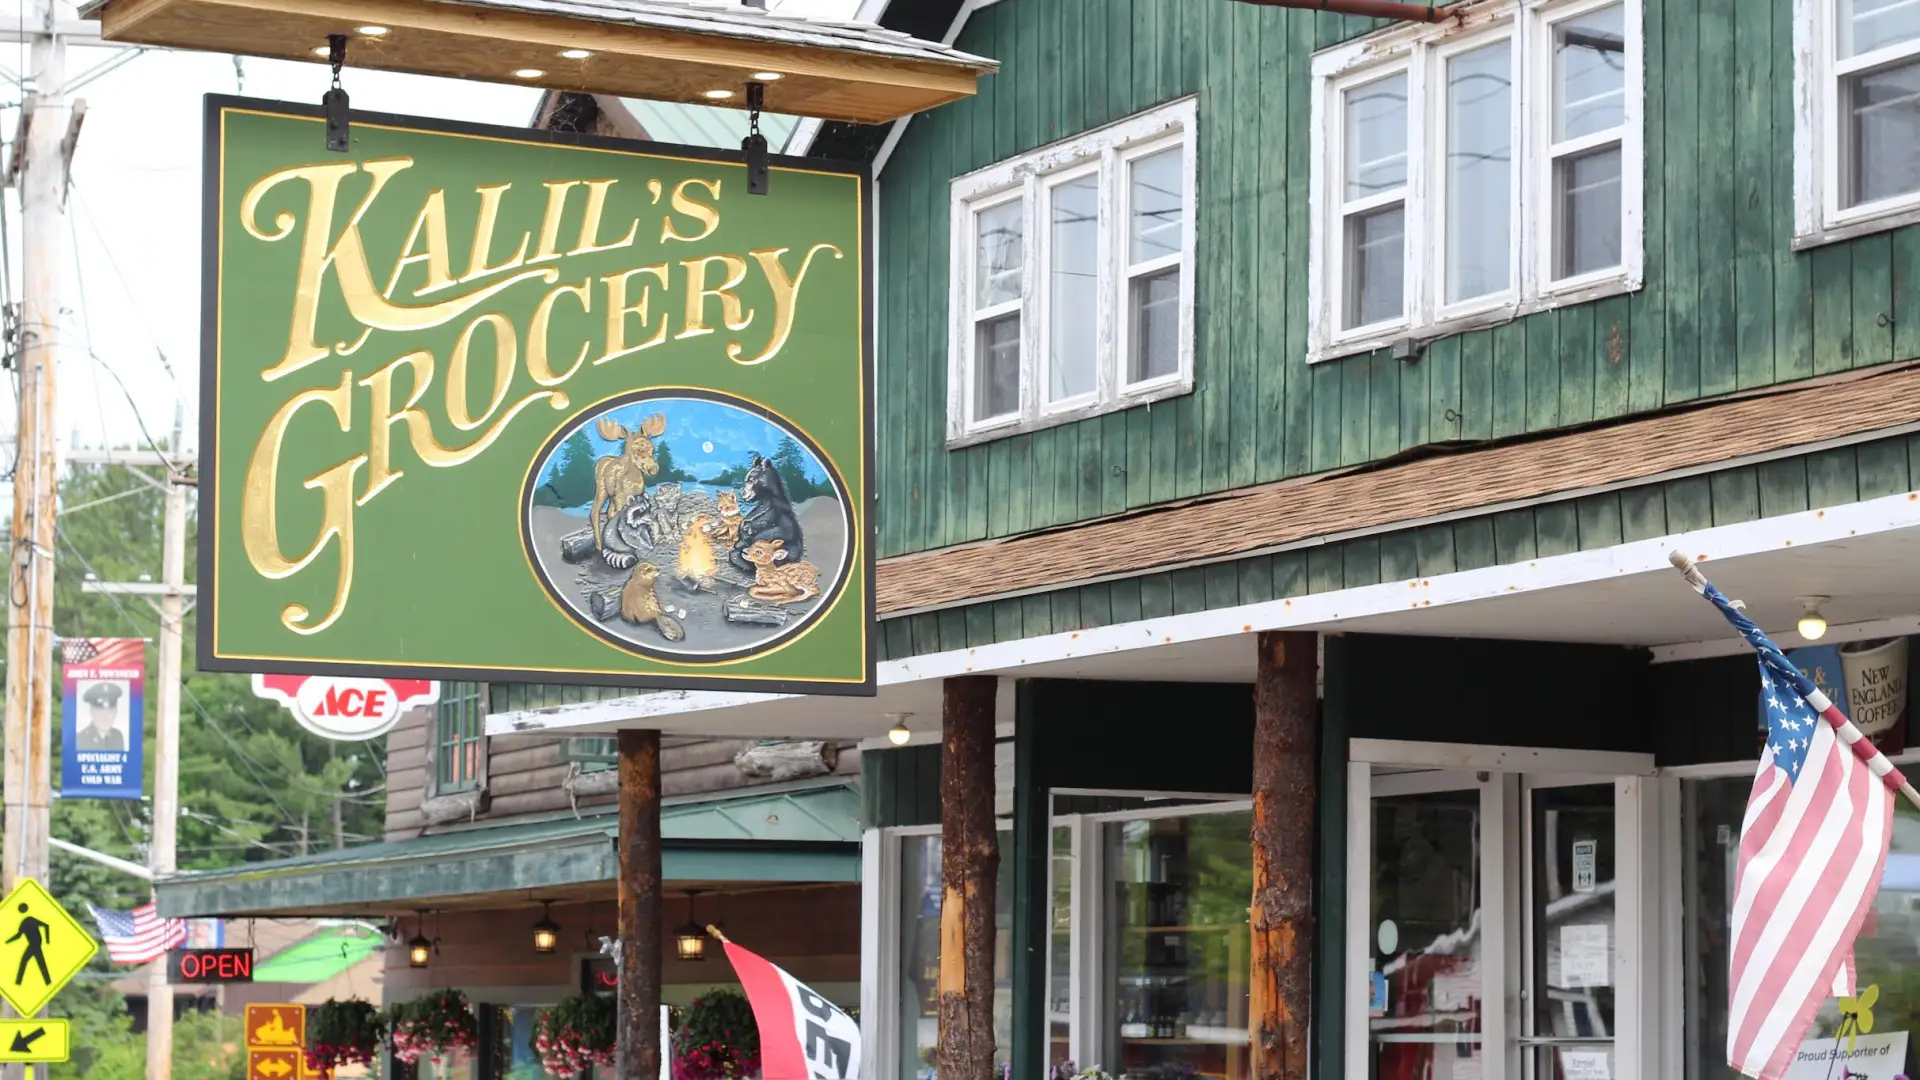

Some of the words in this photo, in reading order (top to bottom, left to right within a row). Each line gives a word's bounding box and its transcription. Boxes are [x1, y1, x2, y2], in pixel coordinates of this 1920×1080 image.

[240, 155, 722, 382] KALIL'S
[240, 242, 844, 635] GROCERY
[1861, 664, 1891, 687] NEW
[313, 684, 386, 718] ACE
[1852, 677, 1901, 706] ENGLAND
[1856, 699, 1898, 724] COFFEE
[81, 775, 103, 785] COLD
[104, 775, 122, 785] WAR
[99, 764, 123, 774] ARMY
[181, 952, 250, 978] OPEN
[1797, 1050, 1827, 1062] Proud
[1879, 1044, 1891, 1056] of
